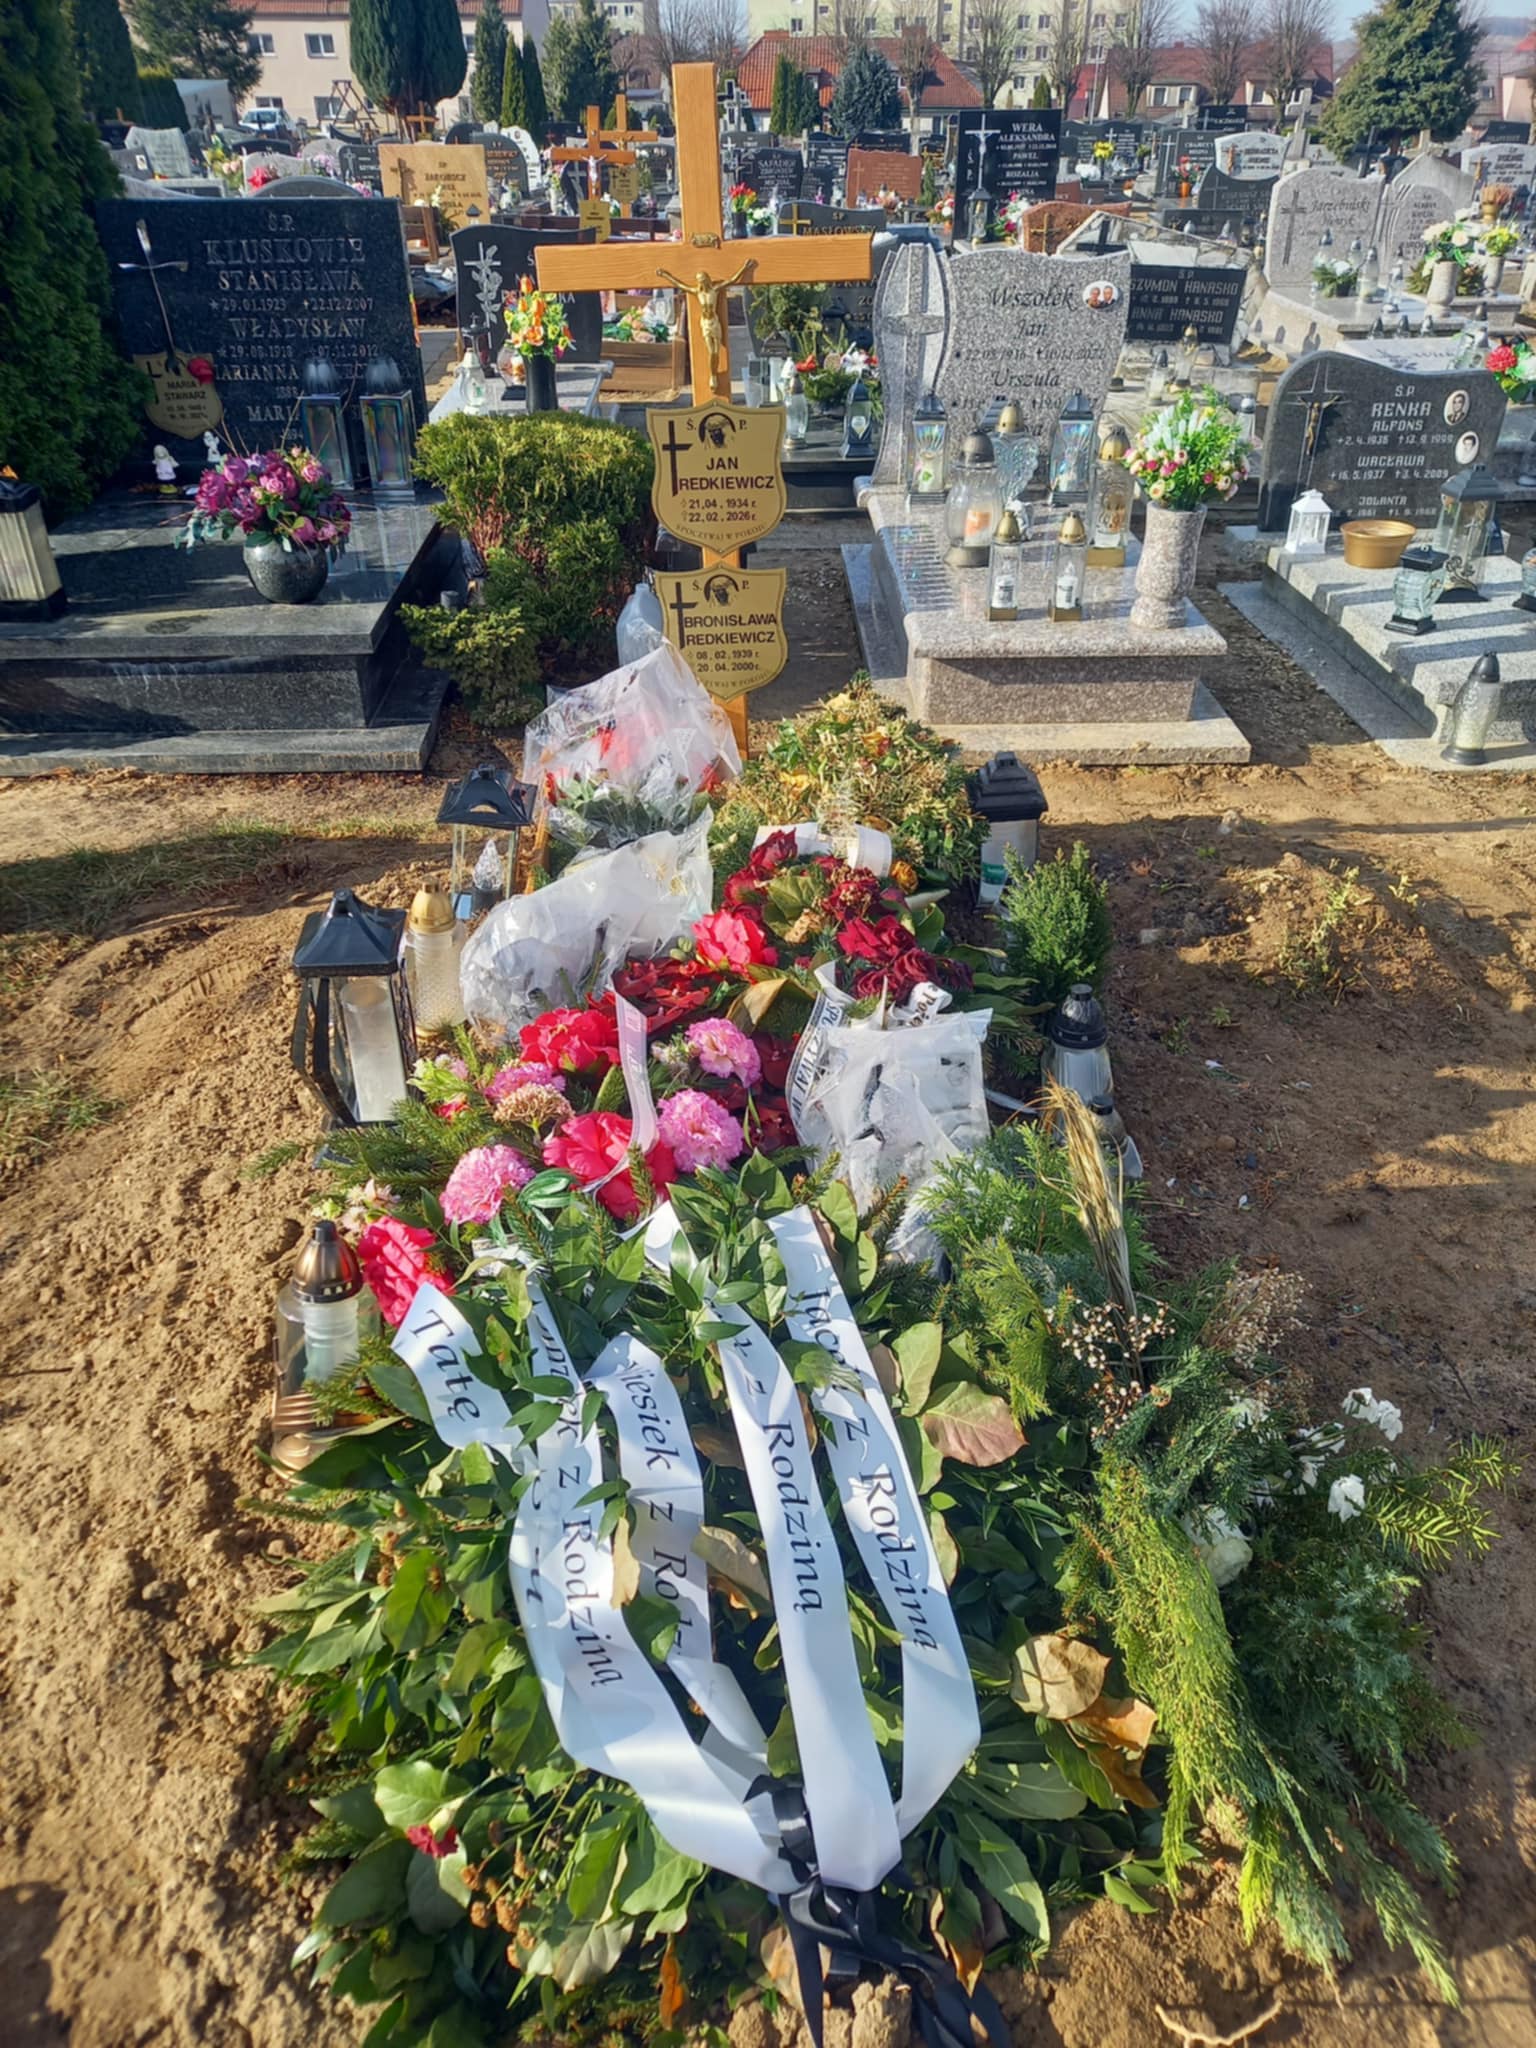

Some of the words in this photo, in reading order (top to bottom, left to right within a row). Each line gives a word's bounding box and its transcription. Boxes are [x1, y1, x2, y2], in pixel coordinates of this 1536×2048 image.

[1012, 122, 1043, 132] WERA
[203, 238, 366, 265] KLUSKOWIE
[218, 270, 365, 291] STANISŁAWA
[229, 318, 367, 338] WŁADYSŁAW
[992, 367, 1061, 388] Urszula
[1371, 402, 1432, 417] RENKA
[1372, 419, 1425, 432] ALFONS
[706, 457, 739, 471] JAN
[1357, 455, 1425, 467] WACŁAWA
[679, 475, 775, 491] REDKIEWICZ
[684, 613, 778, 628] BRONISŁAWA
[685, 631, 776, 646] REDKIEWICZ
[410, 1309, 481, 1423] Tatę
[558, 1466, 581, 1489] z
[650, 1499, 673, 1523] z
[762, 1422, 824, 1616] Rodziną
[847, 1417, 870, 1442] z
[859, 1470, 939, 1652] Rodziną
[562, 1515, 624, 1687] Rodziną
